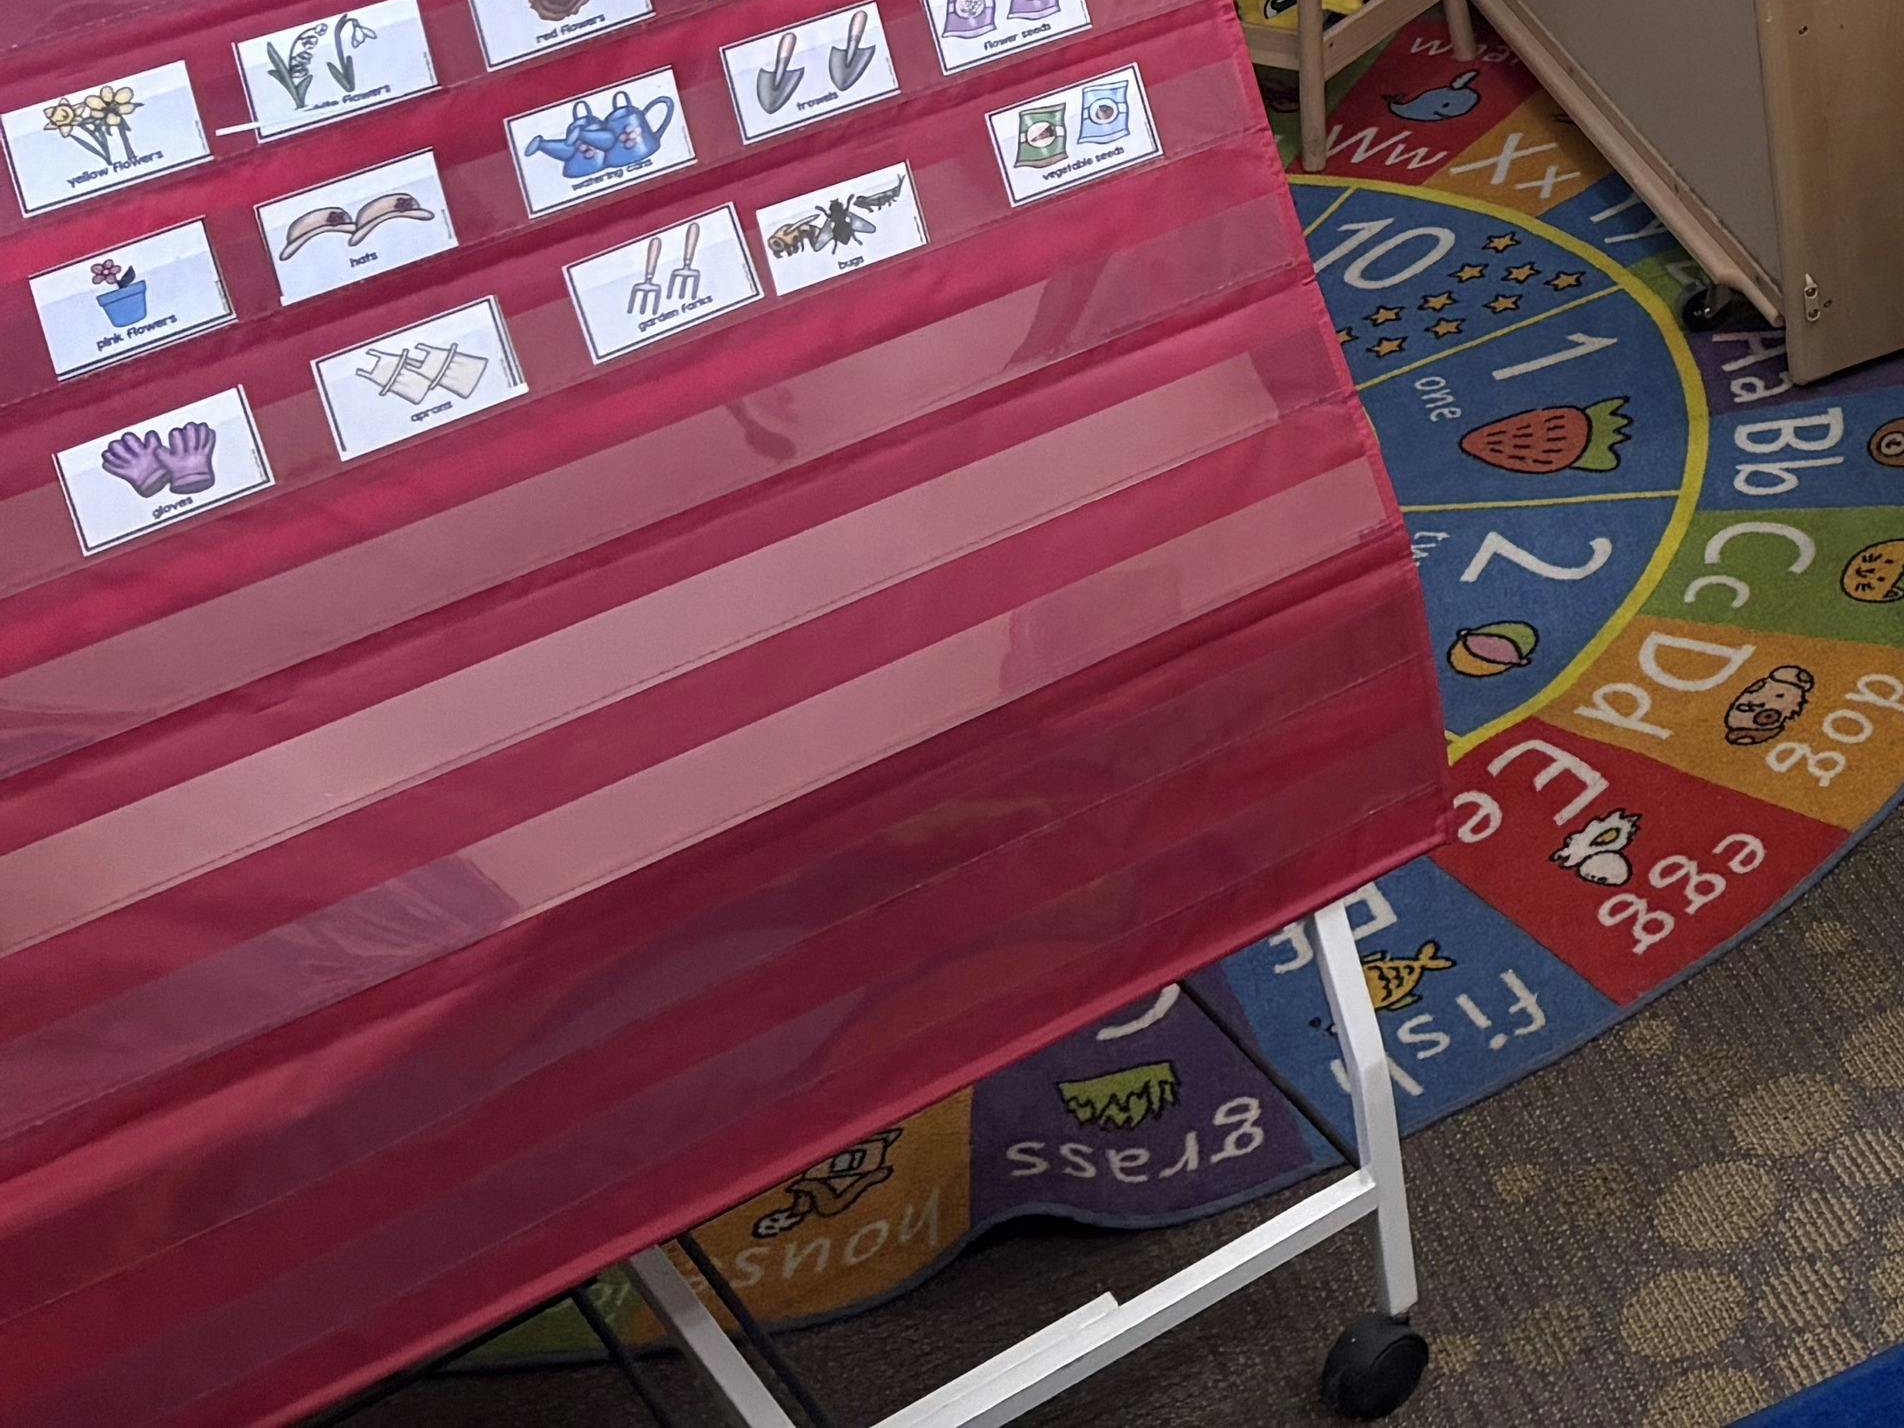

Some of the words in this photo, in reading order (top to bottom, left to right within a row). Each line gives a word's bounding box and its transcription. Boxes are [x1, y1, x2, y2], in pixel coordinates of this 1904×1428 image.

[67, 168, 108, 188] yellow
[113, 150, 164, 173] flowers
[1043, 158, 1093, 180] vegetable
[1095, 147, 1124, 162] seeds
[350, 253, 378, 267] hats
[838, 256, 864, 269] bugs
[97, 333, 124, 351] pink
[127, 315, 177, 338] flowers
[1492, 332, 1619, 382] 1
[1415, 375, 1460, 423] one
[1731, 406, 1845, 496] Bb
[153, 497, 193, 519] gloves
[1460, 531, 1612, 585] 2
[1704, 521, 1815, 607] Cc
[1576, 630, 1757, 740] Dd
[1597, 832, 1767, 954] egg
[1007, 1096, 1266, 1177] grass
